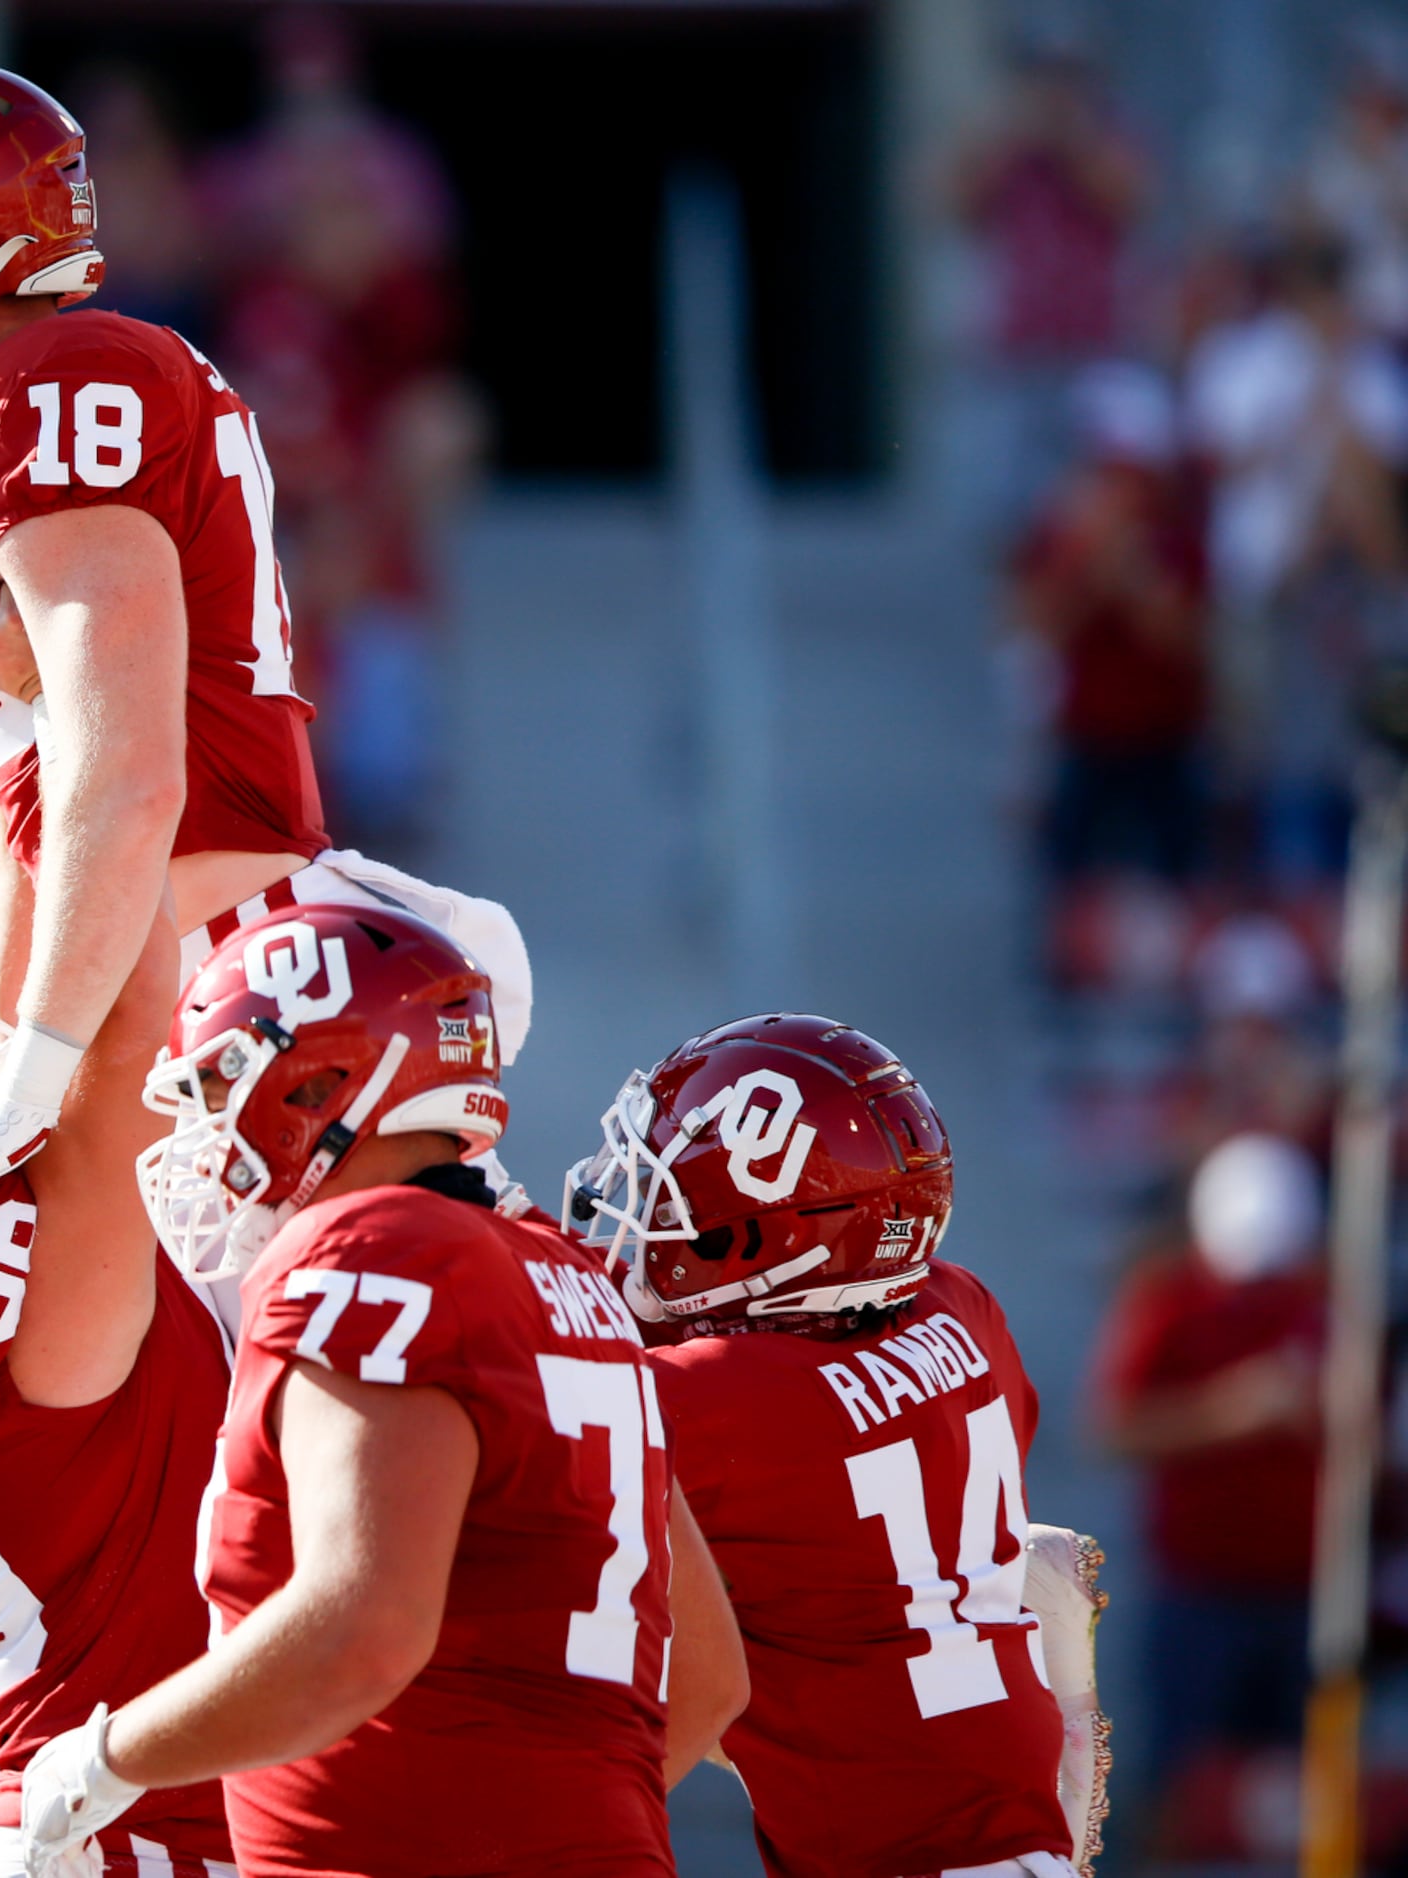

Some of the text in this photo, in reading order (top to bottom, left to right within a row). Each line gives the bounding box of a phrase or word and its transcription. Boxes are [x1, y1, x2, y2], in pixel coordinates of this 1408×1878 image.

[29, 381, 143, 488] 18
[214, 410, 300, 699] 1
[243, 921, 354, 1025] OU
[438, 1043, 472, 1064] UNITY
[719, 1069, 817, 1202] OU
[874, 1242, 912, 1259] UNITY
[284, 1269, 433, 1384] 77
[818, 1312, 990, 1434] RAMBO
